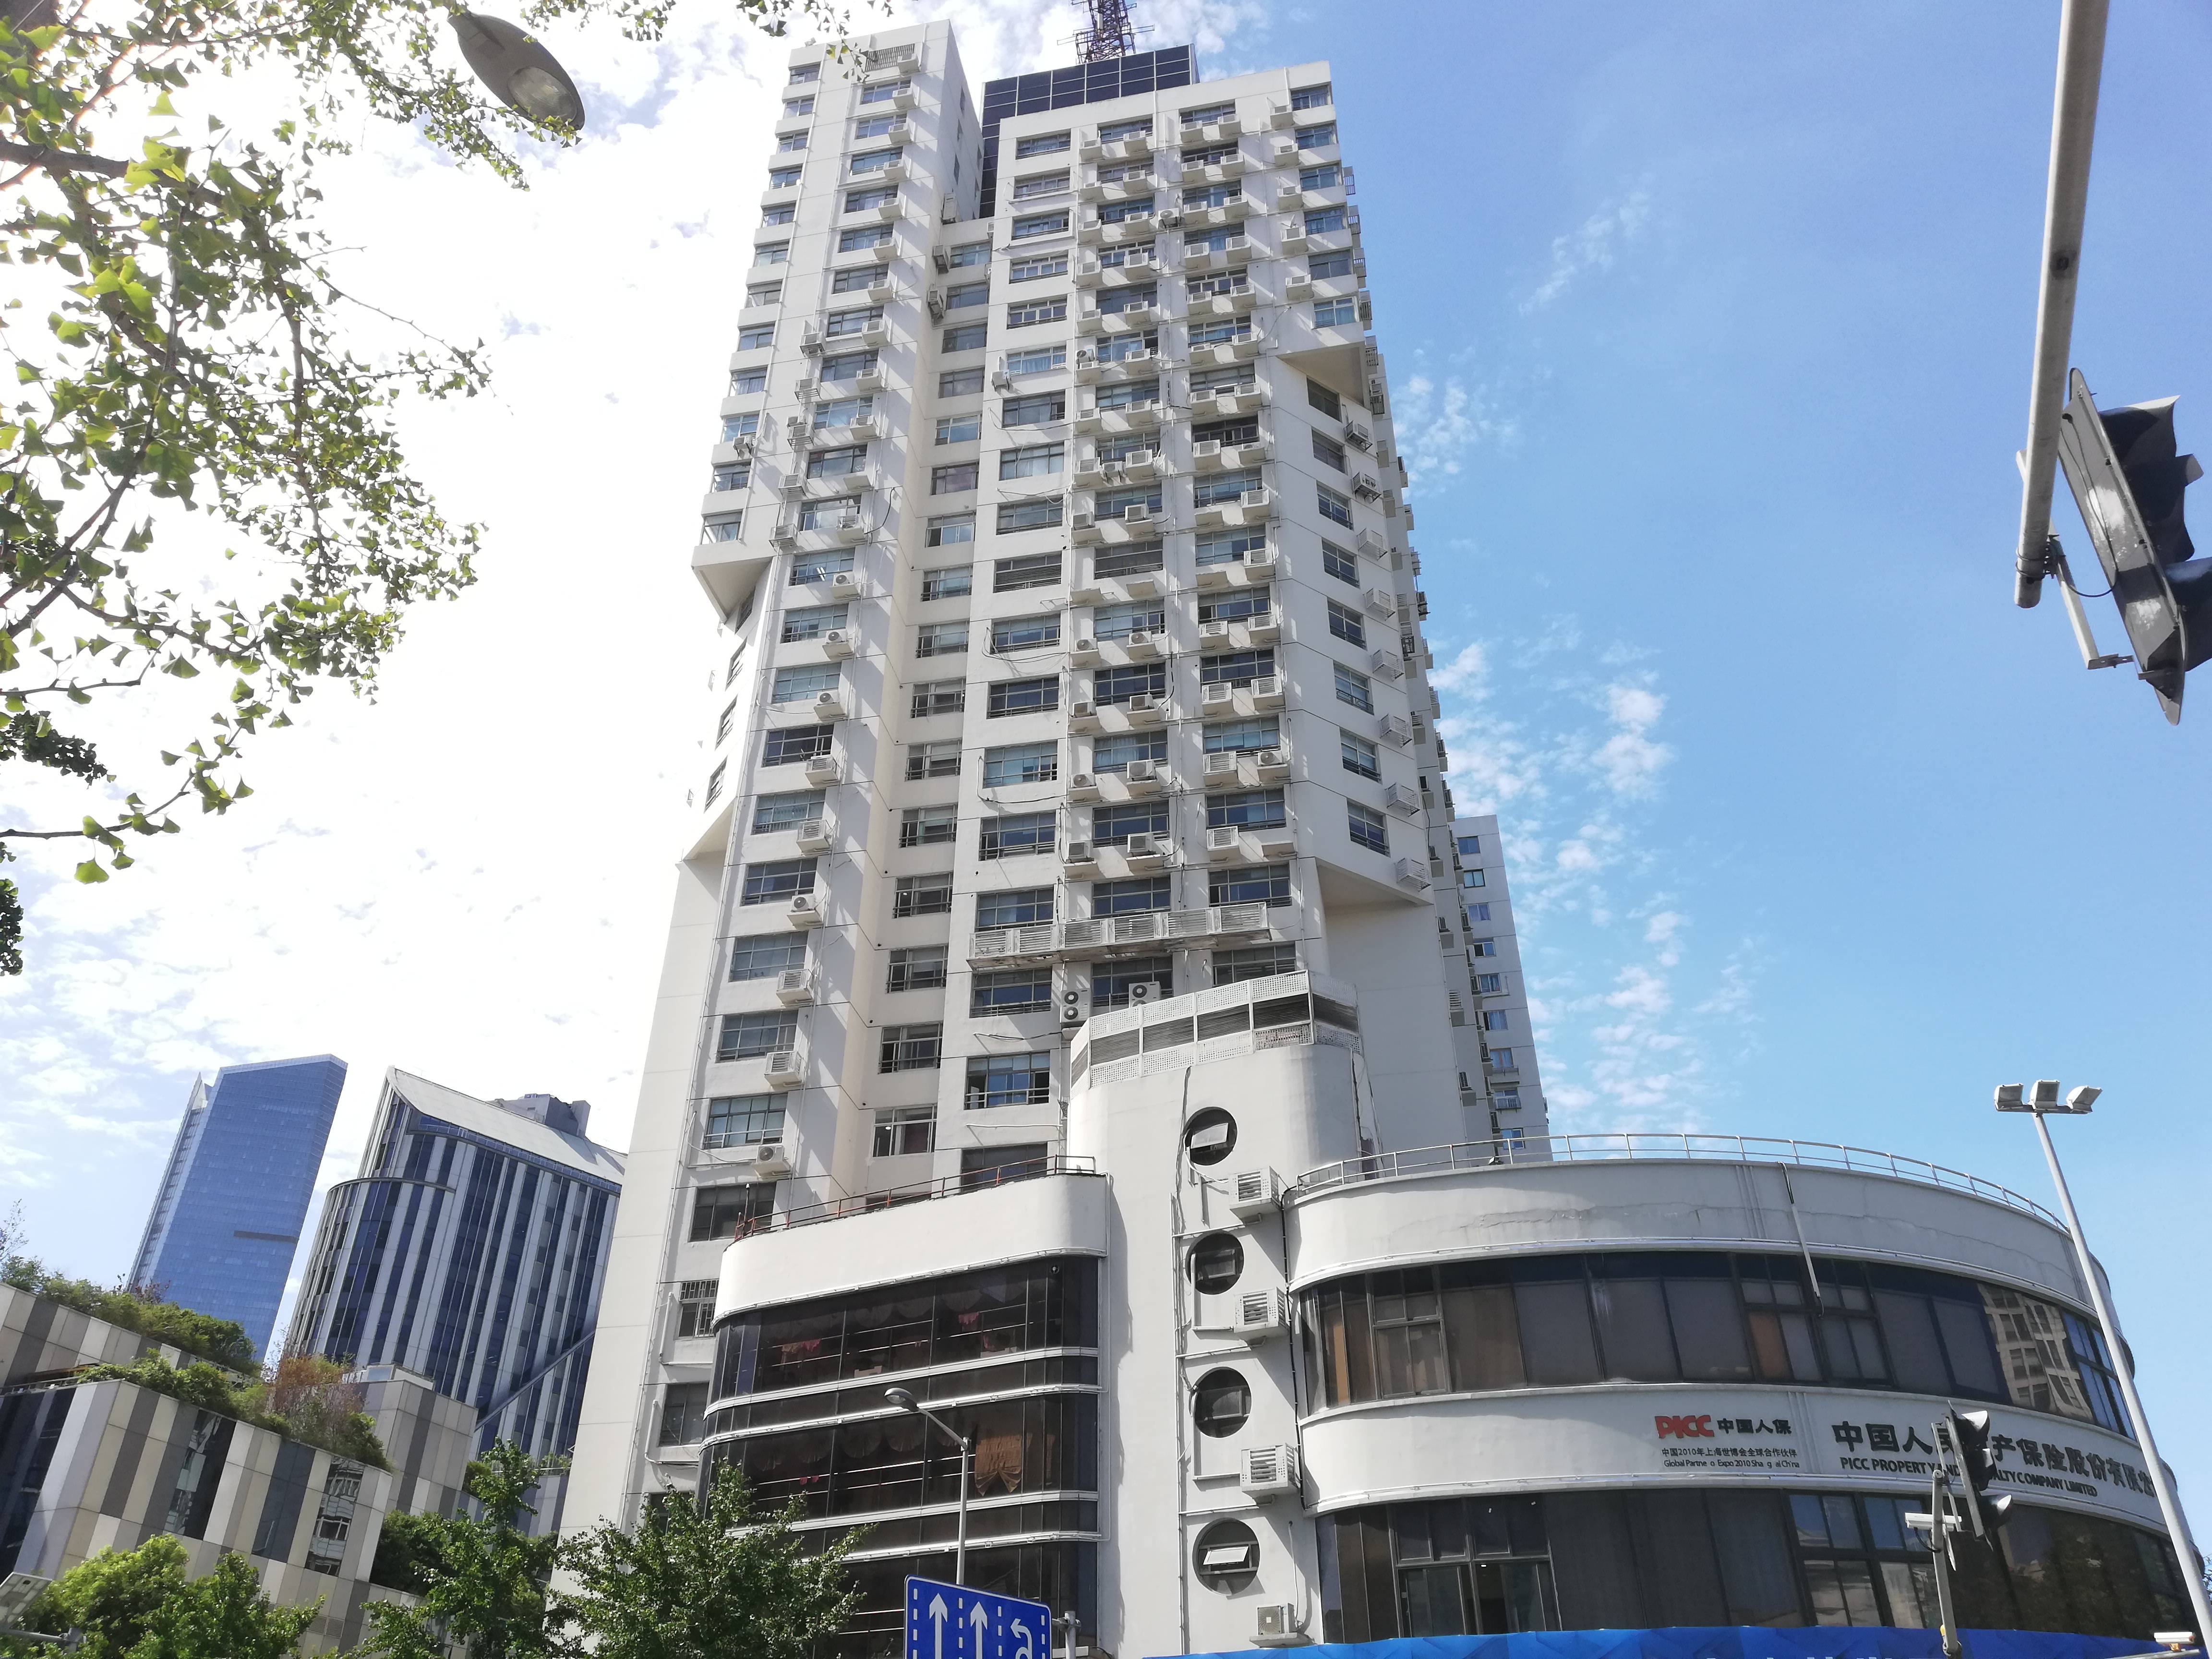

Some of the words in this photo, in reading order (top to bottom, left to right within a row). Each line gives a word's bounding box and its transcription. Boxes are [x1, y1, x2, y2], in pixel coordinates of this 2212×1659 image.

[1655, 1415, 1714, 1439] PICC
[1717, 1418, 1792, 1434] 中国人保
[1662, 1447, 1797, 1458] 中国2010年上海世博会全球合作伙伴
[1831, 1421, 2155, 1497] 中国人民产保险股份有限公
[1840, 1457, 1870, 1470] PICC
[1871, 1458, 1935, 1474] PROPERTY
[2017, 1472, 2064, 1490] COMPANY
[2064, 1479, 2098, 1497] LIMITED
